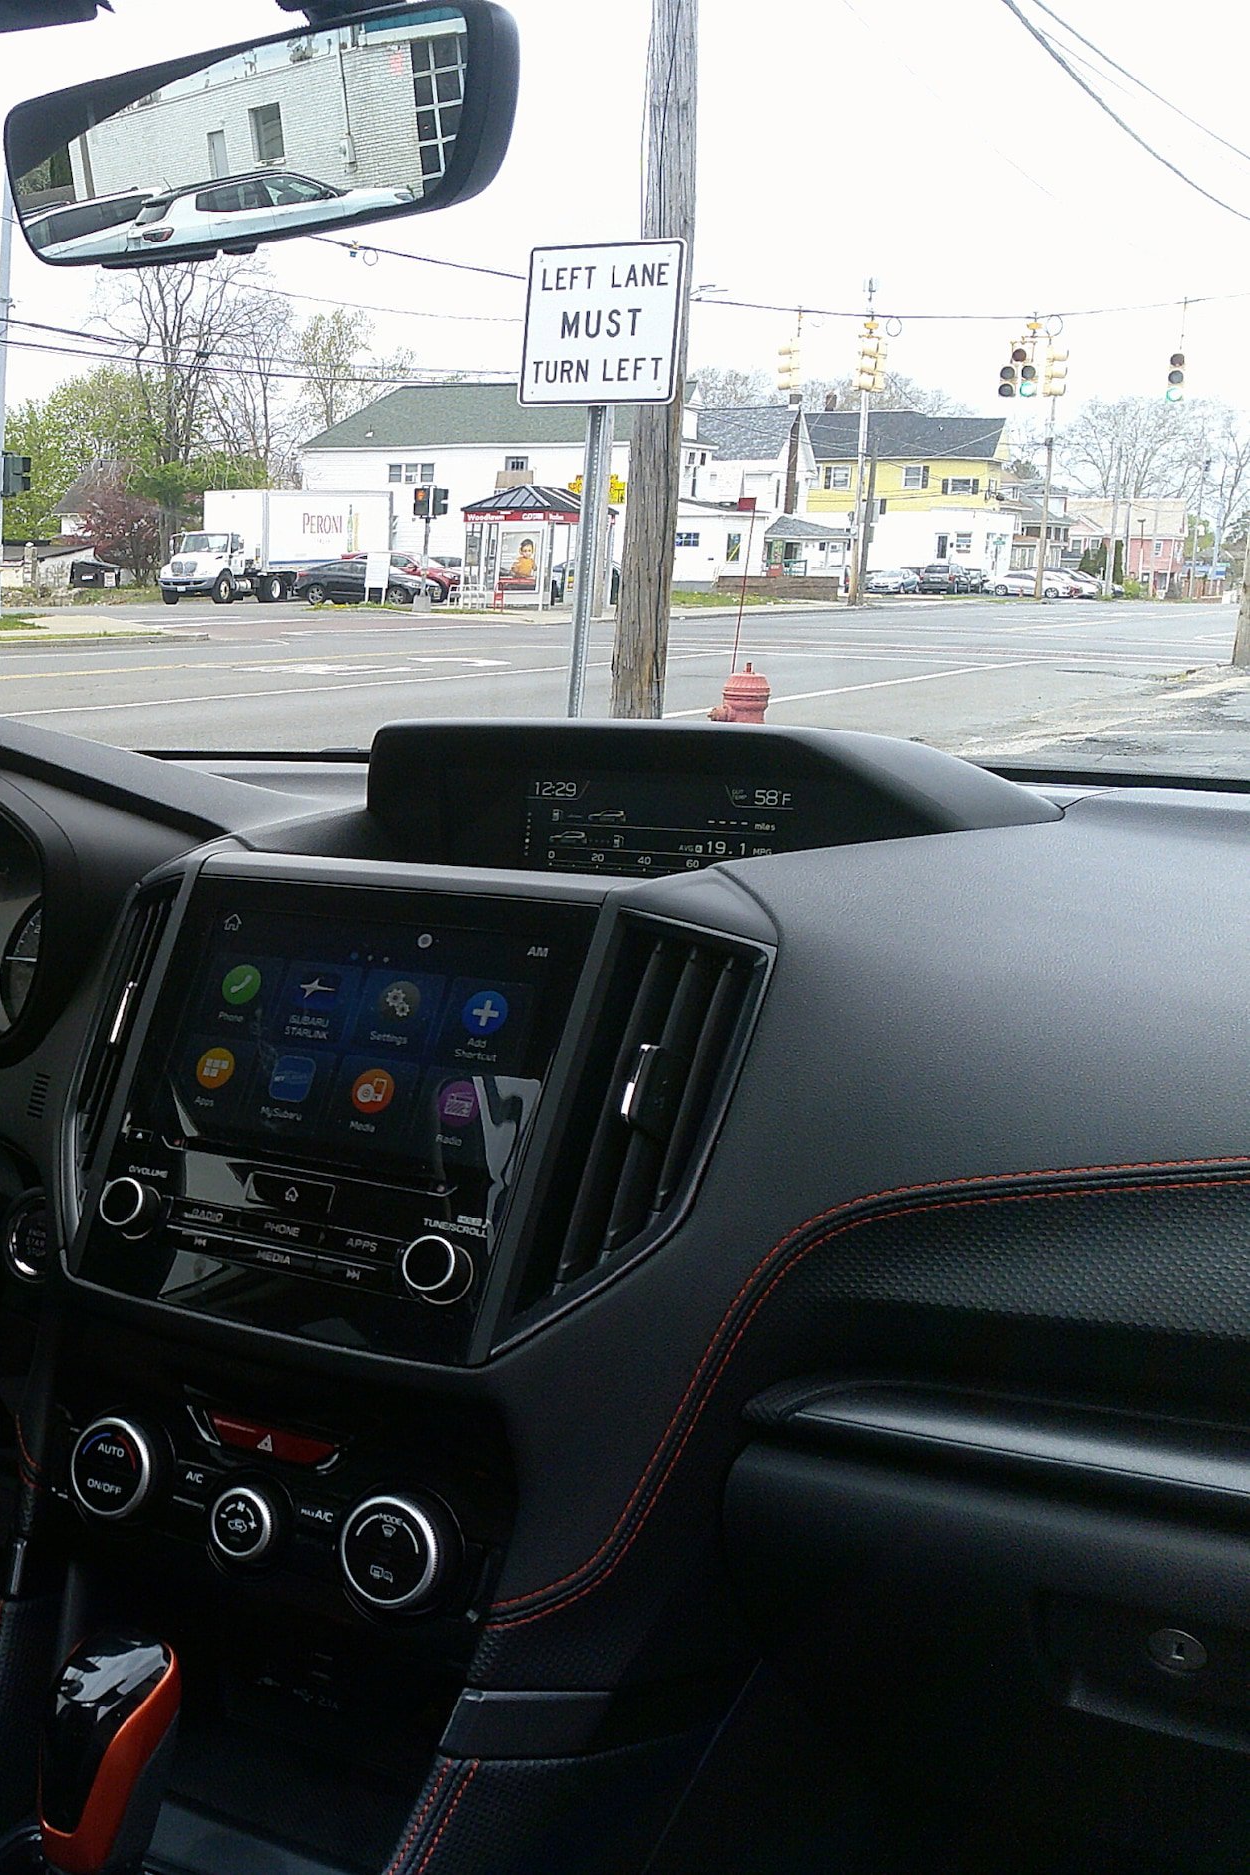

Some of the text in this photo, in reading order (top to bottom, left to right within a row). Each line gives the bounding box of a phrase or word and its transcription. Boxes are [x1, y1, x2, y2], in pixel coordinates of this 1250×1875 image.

[542, 263, 670, 291] LEFT LANE
[561, 308, 642, 339] MUST
[533, 357, 663, 384] TURN LEFT
[302, 512, 343, 534] PERONI
[535, 781, 577, 797] 12:29
[754, 823, 776, 832] miles
[678, 844, 694, 852] AVG
[707, 840, 746, 856] 19.1
[752, 847, 772, 856] MPG
[548, 850, 700, 869] 0 20 40 60
[527, 946, 549, 959] AM
[218, 1010, 244, 1023] Phone
[288, 1014, 330, 1028] SUBARU
[284, 1026, 329, 1041] STARLINK
[369, 1030, 409, 1047] Settings
[466, 1037, 488, 1049] Add
[454, 1048, 498, 1063] Shortcut
[195, 1095, 214, 1108] Apps
[260, 1105, 303, 1123] MySubaru
[350, 1120, 376, 1134] Media
[435, 1133, 463, 1147] Radio
[191, 1208, 224, 1223] RADIO
[264, 1221, 300, 1238] PHONE
[345, 1237, 378, 1253] APPS
[256, 1250, 291, 1265] MEDIA
[97, 1442, 125, 1458] AUTO
[185, 1471, 205, 1484] A/C
[87, 1478, 122, 1496] ON/OFF
[314, 1509, 334, 1523] A/C
[378, 1513, 404, 1527] MODE
